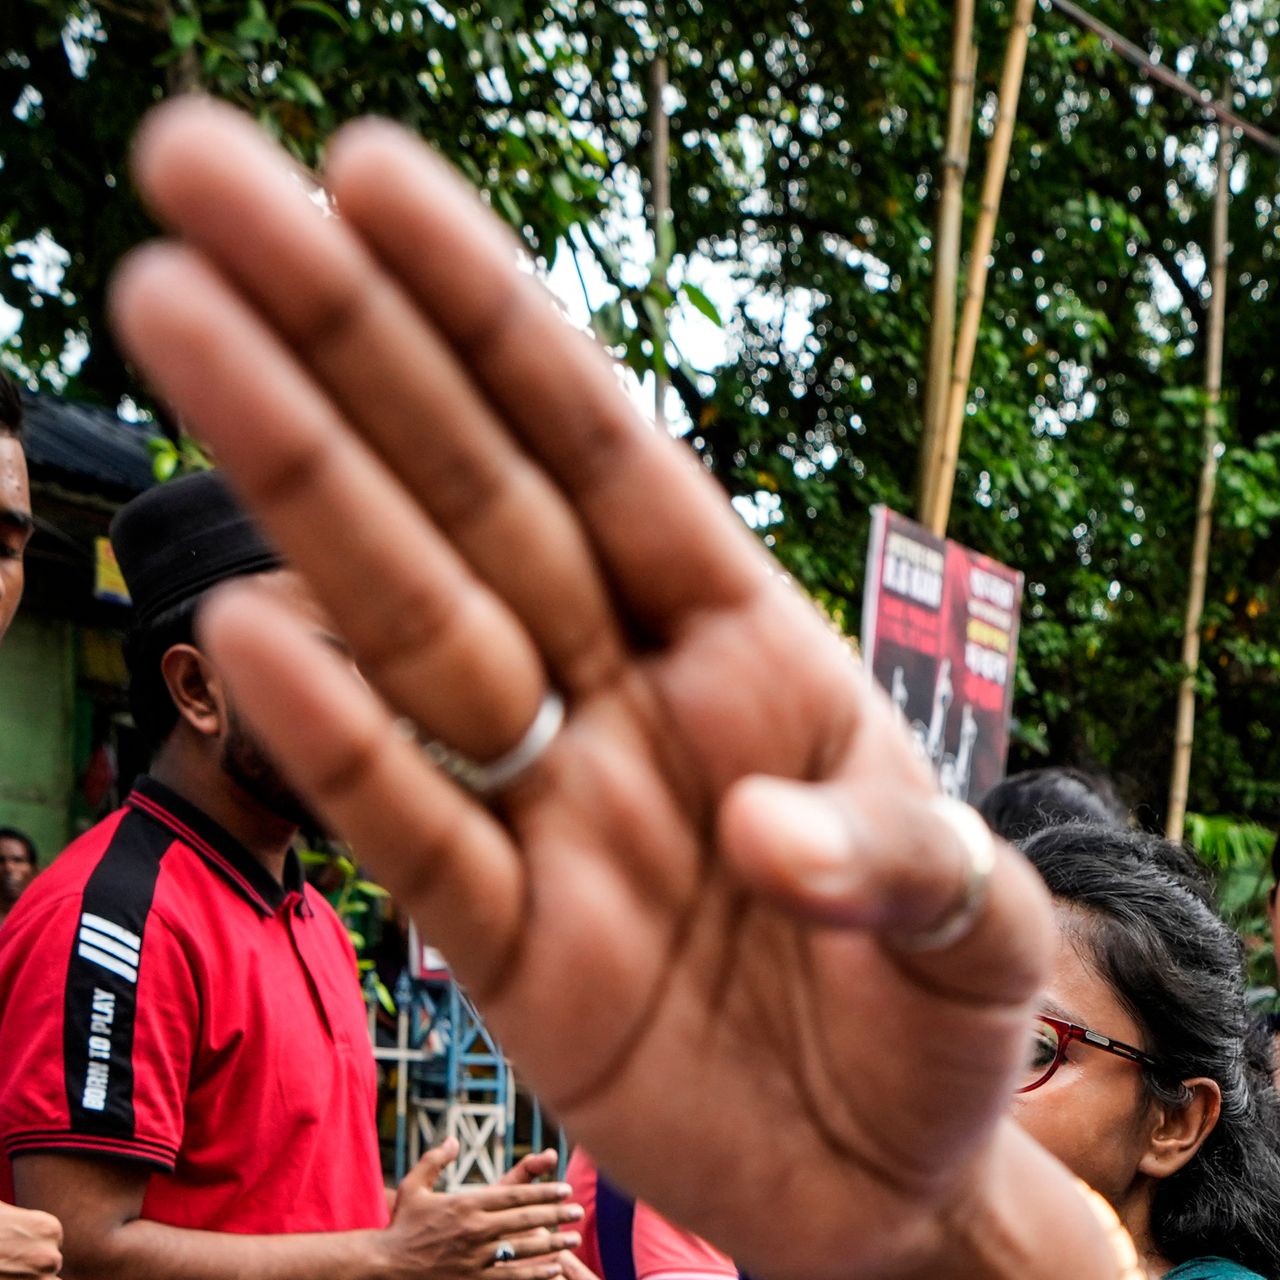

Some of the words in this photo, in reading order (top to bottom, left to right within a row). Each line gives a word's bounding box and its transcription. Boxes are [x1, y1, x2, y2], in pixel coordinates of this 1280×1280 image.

[91, 987, 116, 1036] PLAY
[89, 1035, 111, 1060] TO
[82, 1061, 109, 1111] BORN
